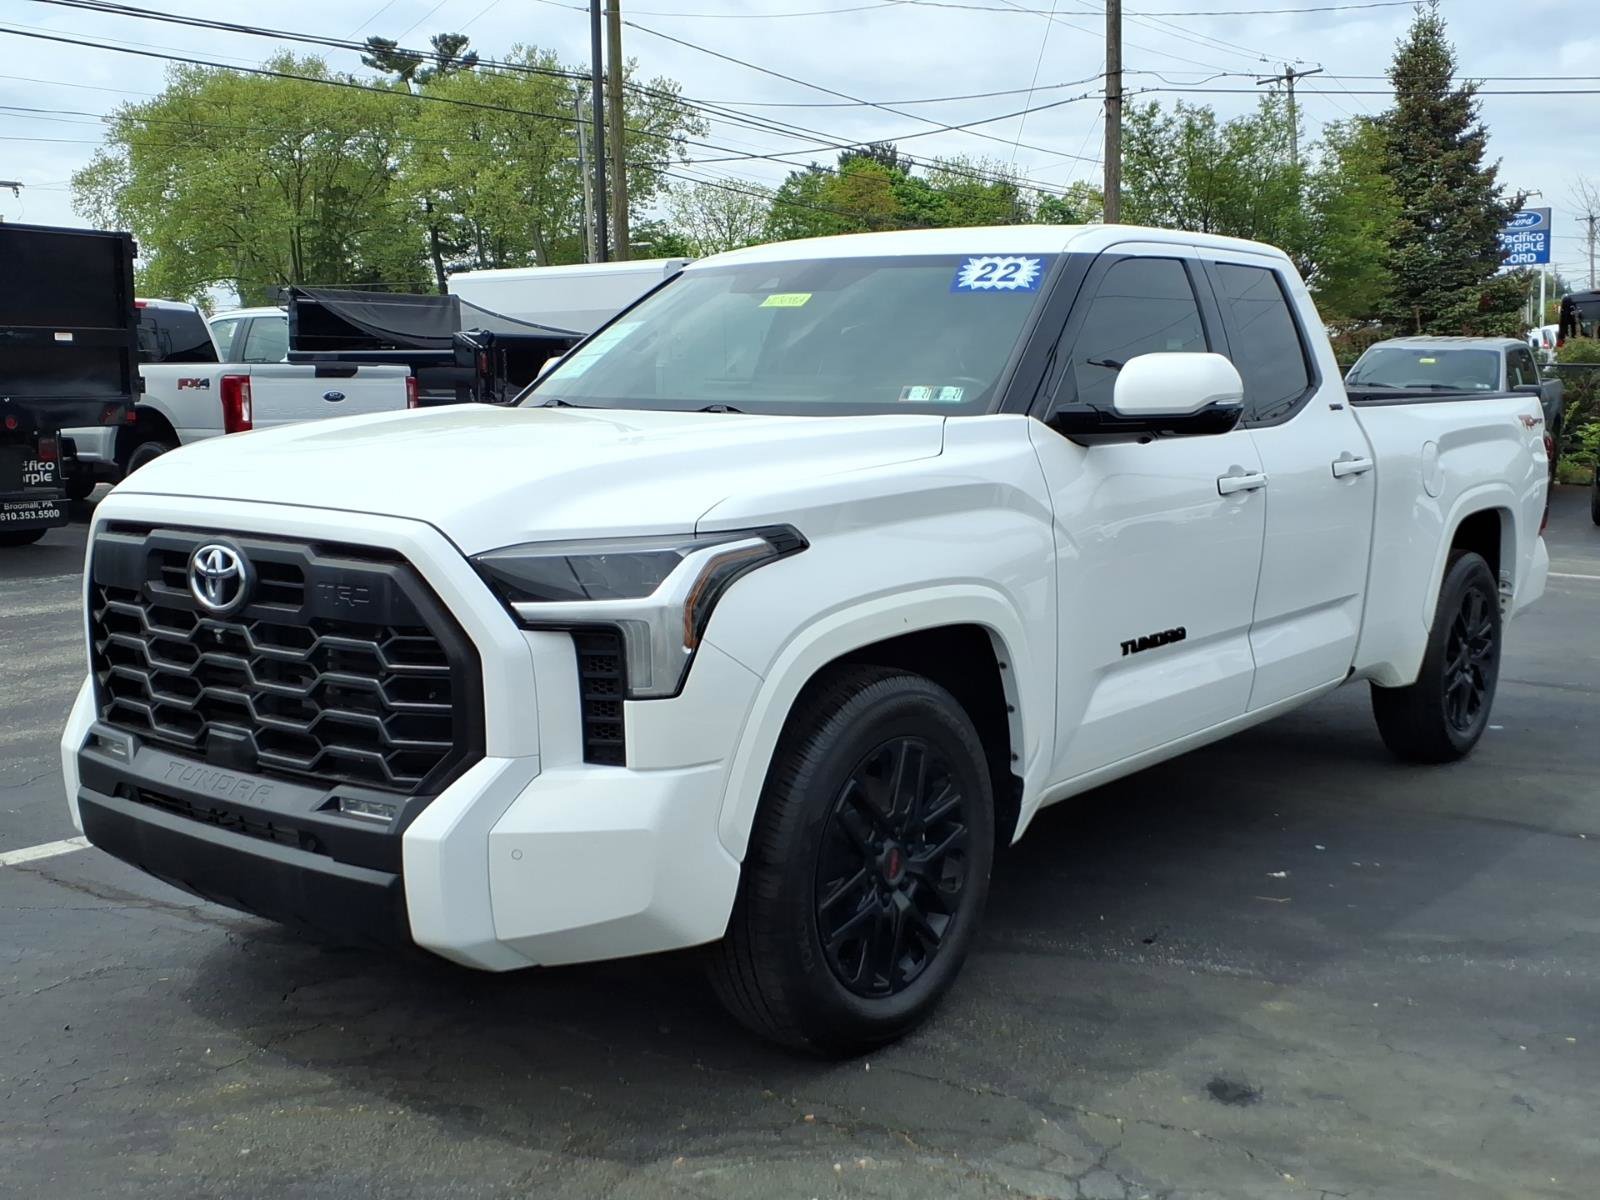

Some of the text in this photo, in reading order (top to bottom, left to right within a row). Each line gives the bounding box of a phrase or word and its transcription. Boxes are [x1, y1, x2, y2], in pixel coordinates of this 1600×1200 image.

[1506, 213, 1534, 226] Ford
[1500, 242, 1544, 252] RPLE
[1502, 253, 1536, 264] ORD
[973, 262, 1023, 283] 22
[178, 378, 210, 390] FX4
[23, 471, 53, 485] rple
[0, 509, 60, 521] 610.353.5500
[1120, 626, 1187, 656] TUNDRA
[164, 761, 275, 804] TUNDRA
